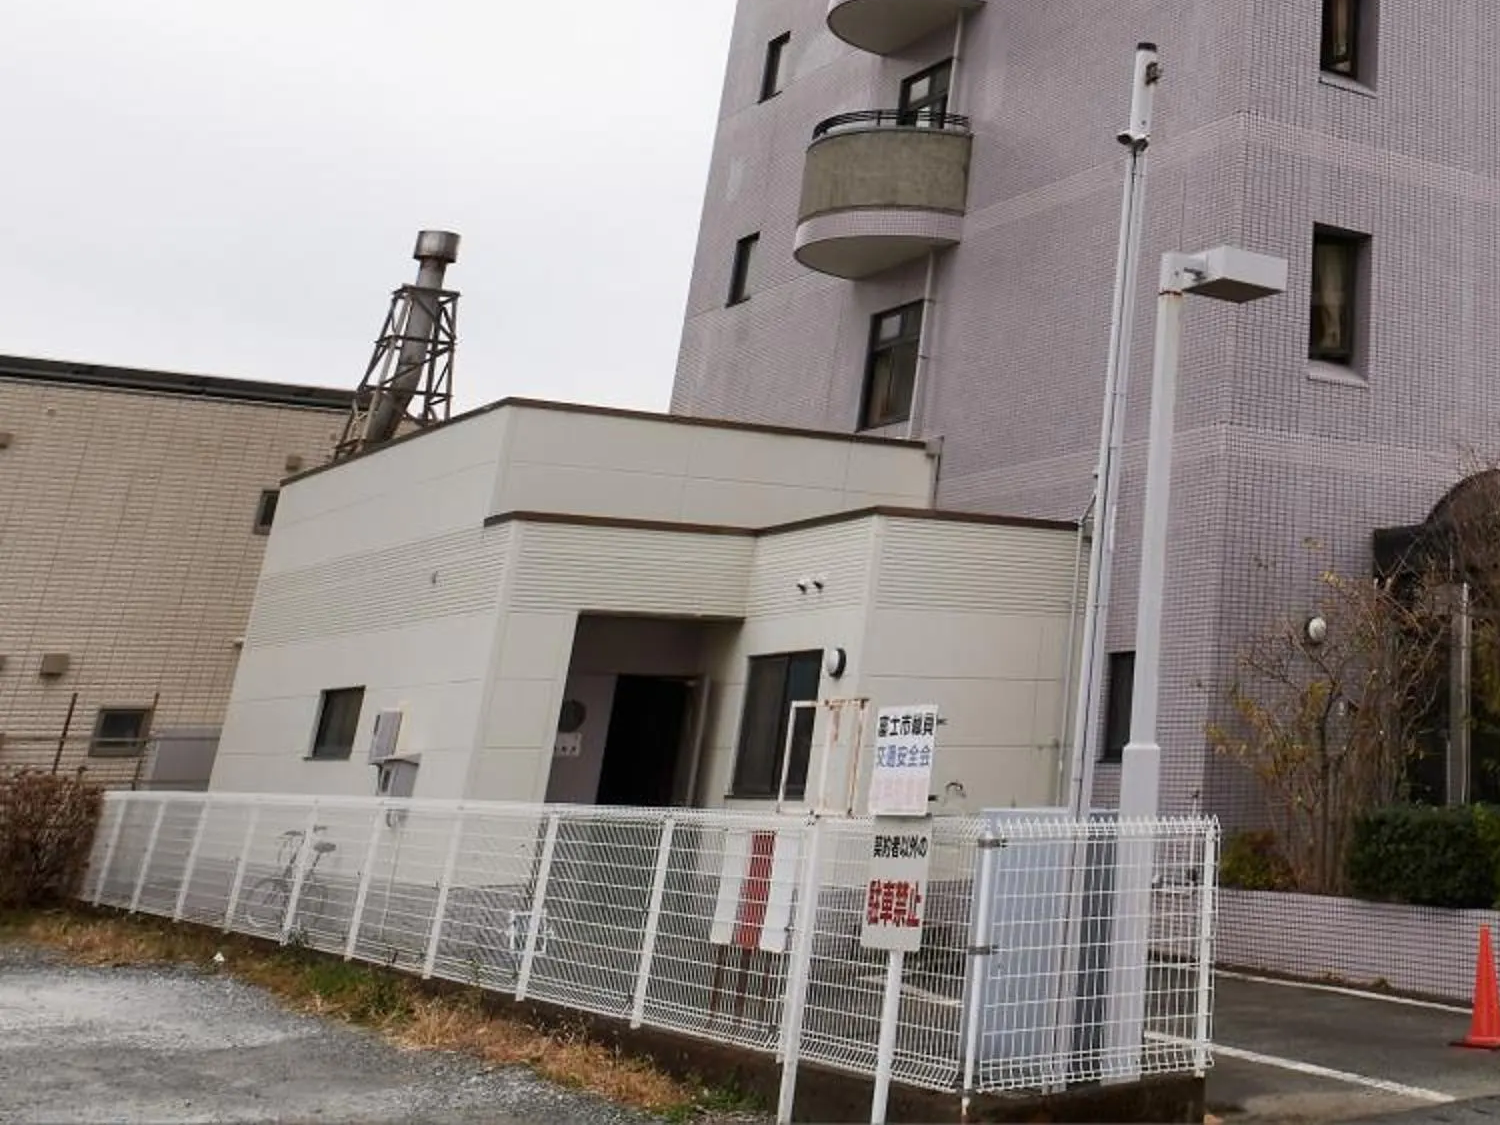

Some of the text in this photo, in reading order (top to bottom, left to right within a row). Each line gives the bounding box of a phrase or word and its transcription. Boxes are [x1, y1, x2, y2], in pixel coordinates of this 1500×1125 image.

[873, 835, 929, 858] 契約者以外の
[866, 879, 922, 928] 駐車禁止
